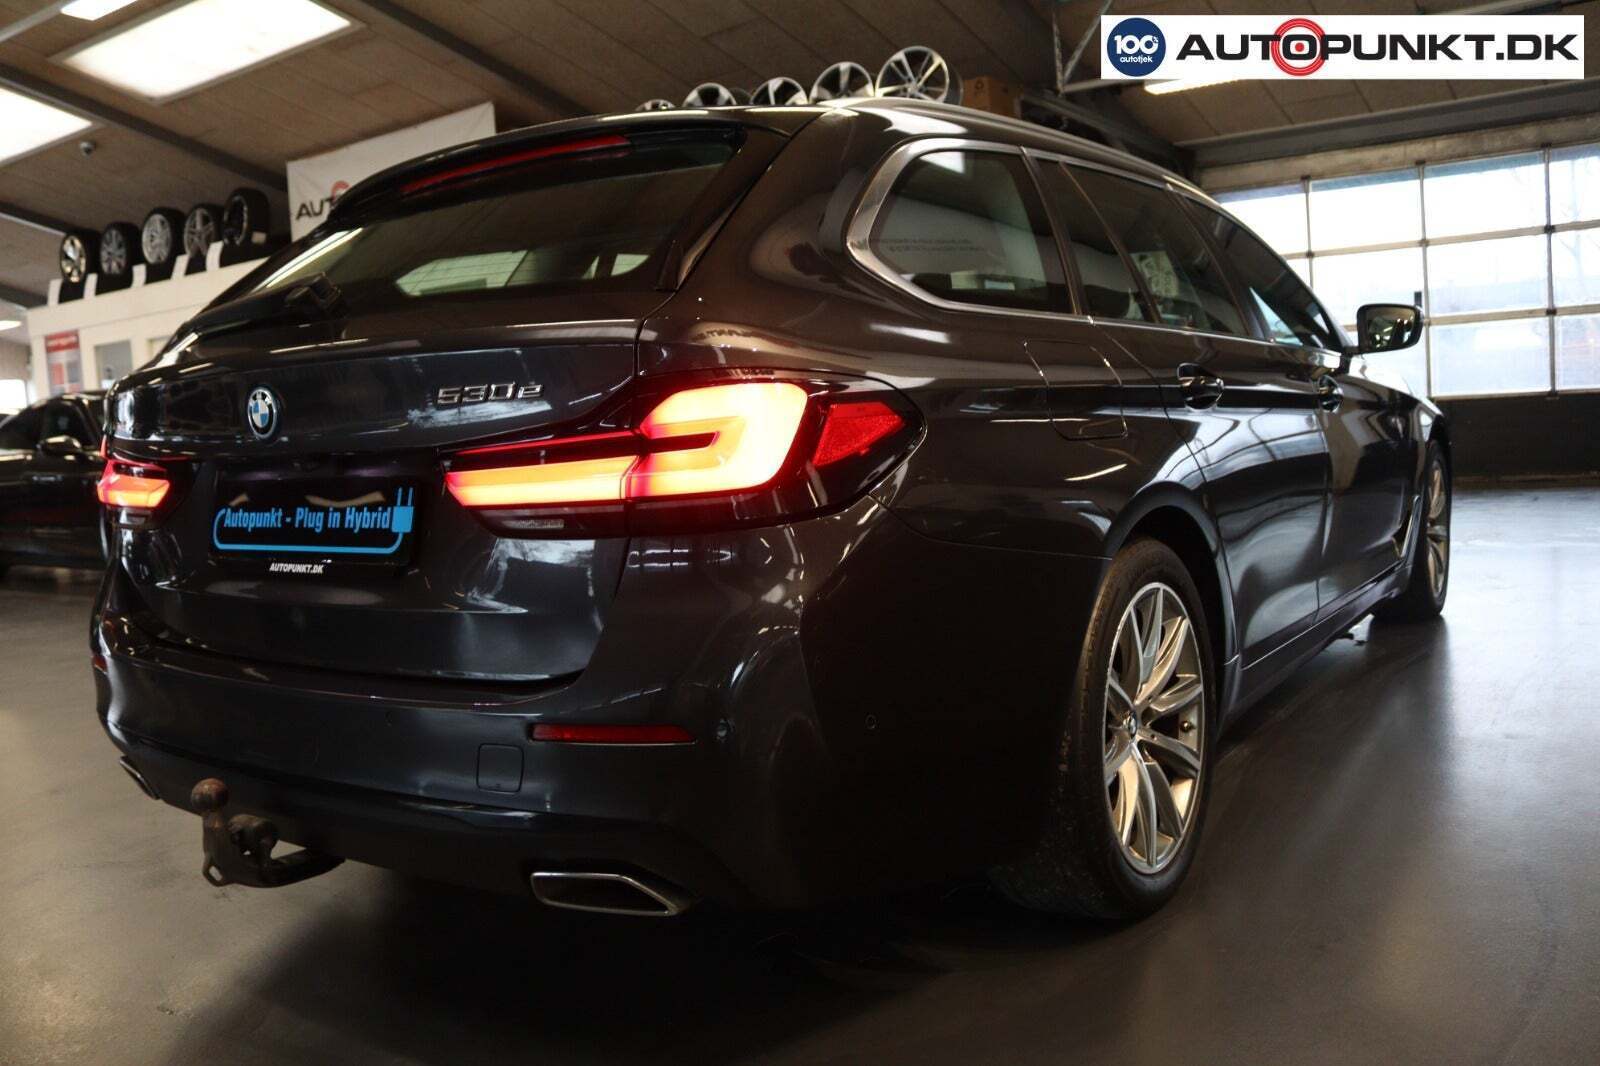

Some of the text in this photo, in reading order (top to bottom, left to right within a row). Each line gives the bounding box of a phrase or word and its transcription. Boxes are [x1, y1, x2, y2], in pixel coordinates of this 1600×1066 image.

[224, 507, 282, 532] Autopunkt
[295, 507, 325, 533] Plug
[328, 507, 341, 529] in
[345, 507, 391, 533] Hybrid
[269, 562, 324, 574] AUTOPUNKT.DK
